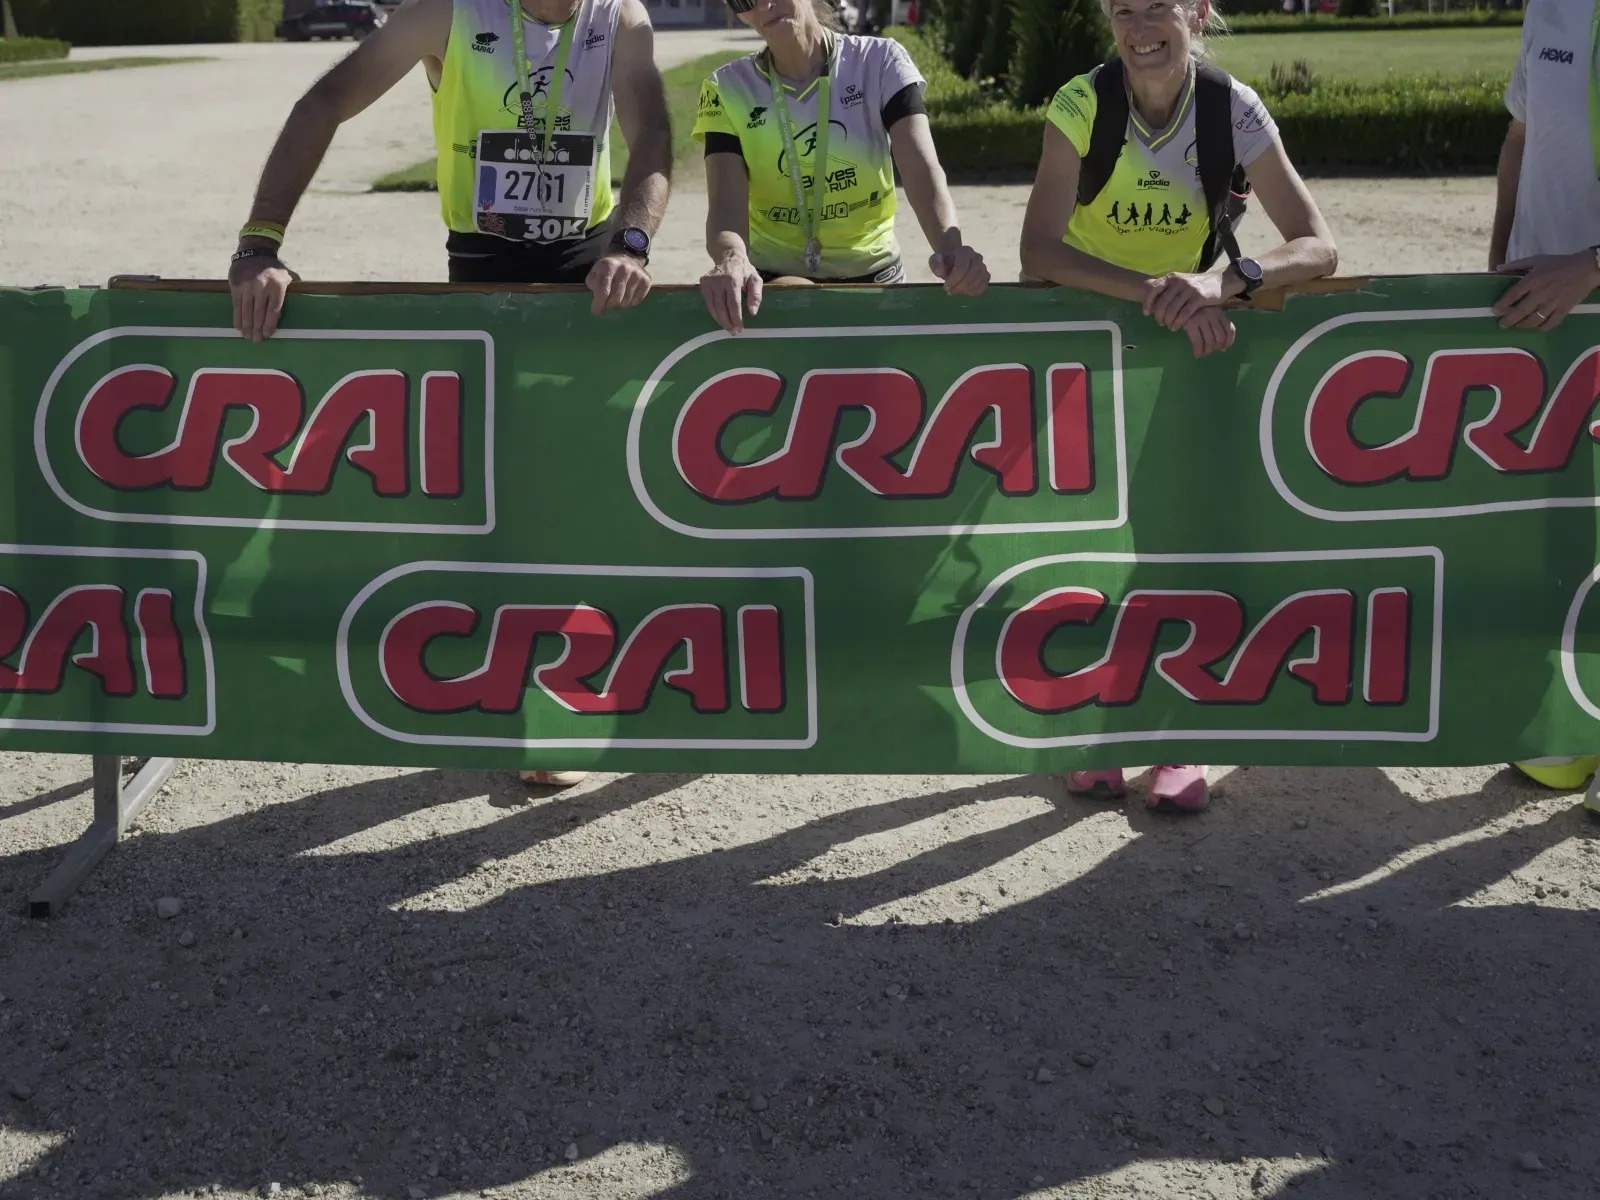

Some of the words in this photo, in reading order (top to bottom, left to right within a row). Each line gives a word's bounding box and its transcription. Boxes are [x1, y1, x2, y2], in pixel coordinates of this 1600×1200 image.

[471, 43, 495, 54] KARHU
[1538, 47, 1574, 65] HOKA
[504, 170, 565, 203] 2761
[801, 167, 856, 189] Bves
[829, 178, 858, 193] RUN
[1137, 178, 1143, 186] il
[1144, 179, 1170, 188] podio
[522, 218, 585, 240] 30K
[1148, 226, 1189, 236] Viaggio
[1304, 345, 1600, 485] CRA
[75, 363, 465, 498] CRAI
[672, 362, 1094, 501] CRAI
[0, 584, 188, 697] AI
[995, 586, 1411, 714] CRAI
[379, 601, 786, 713] CRAI
